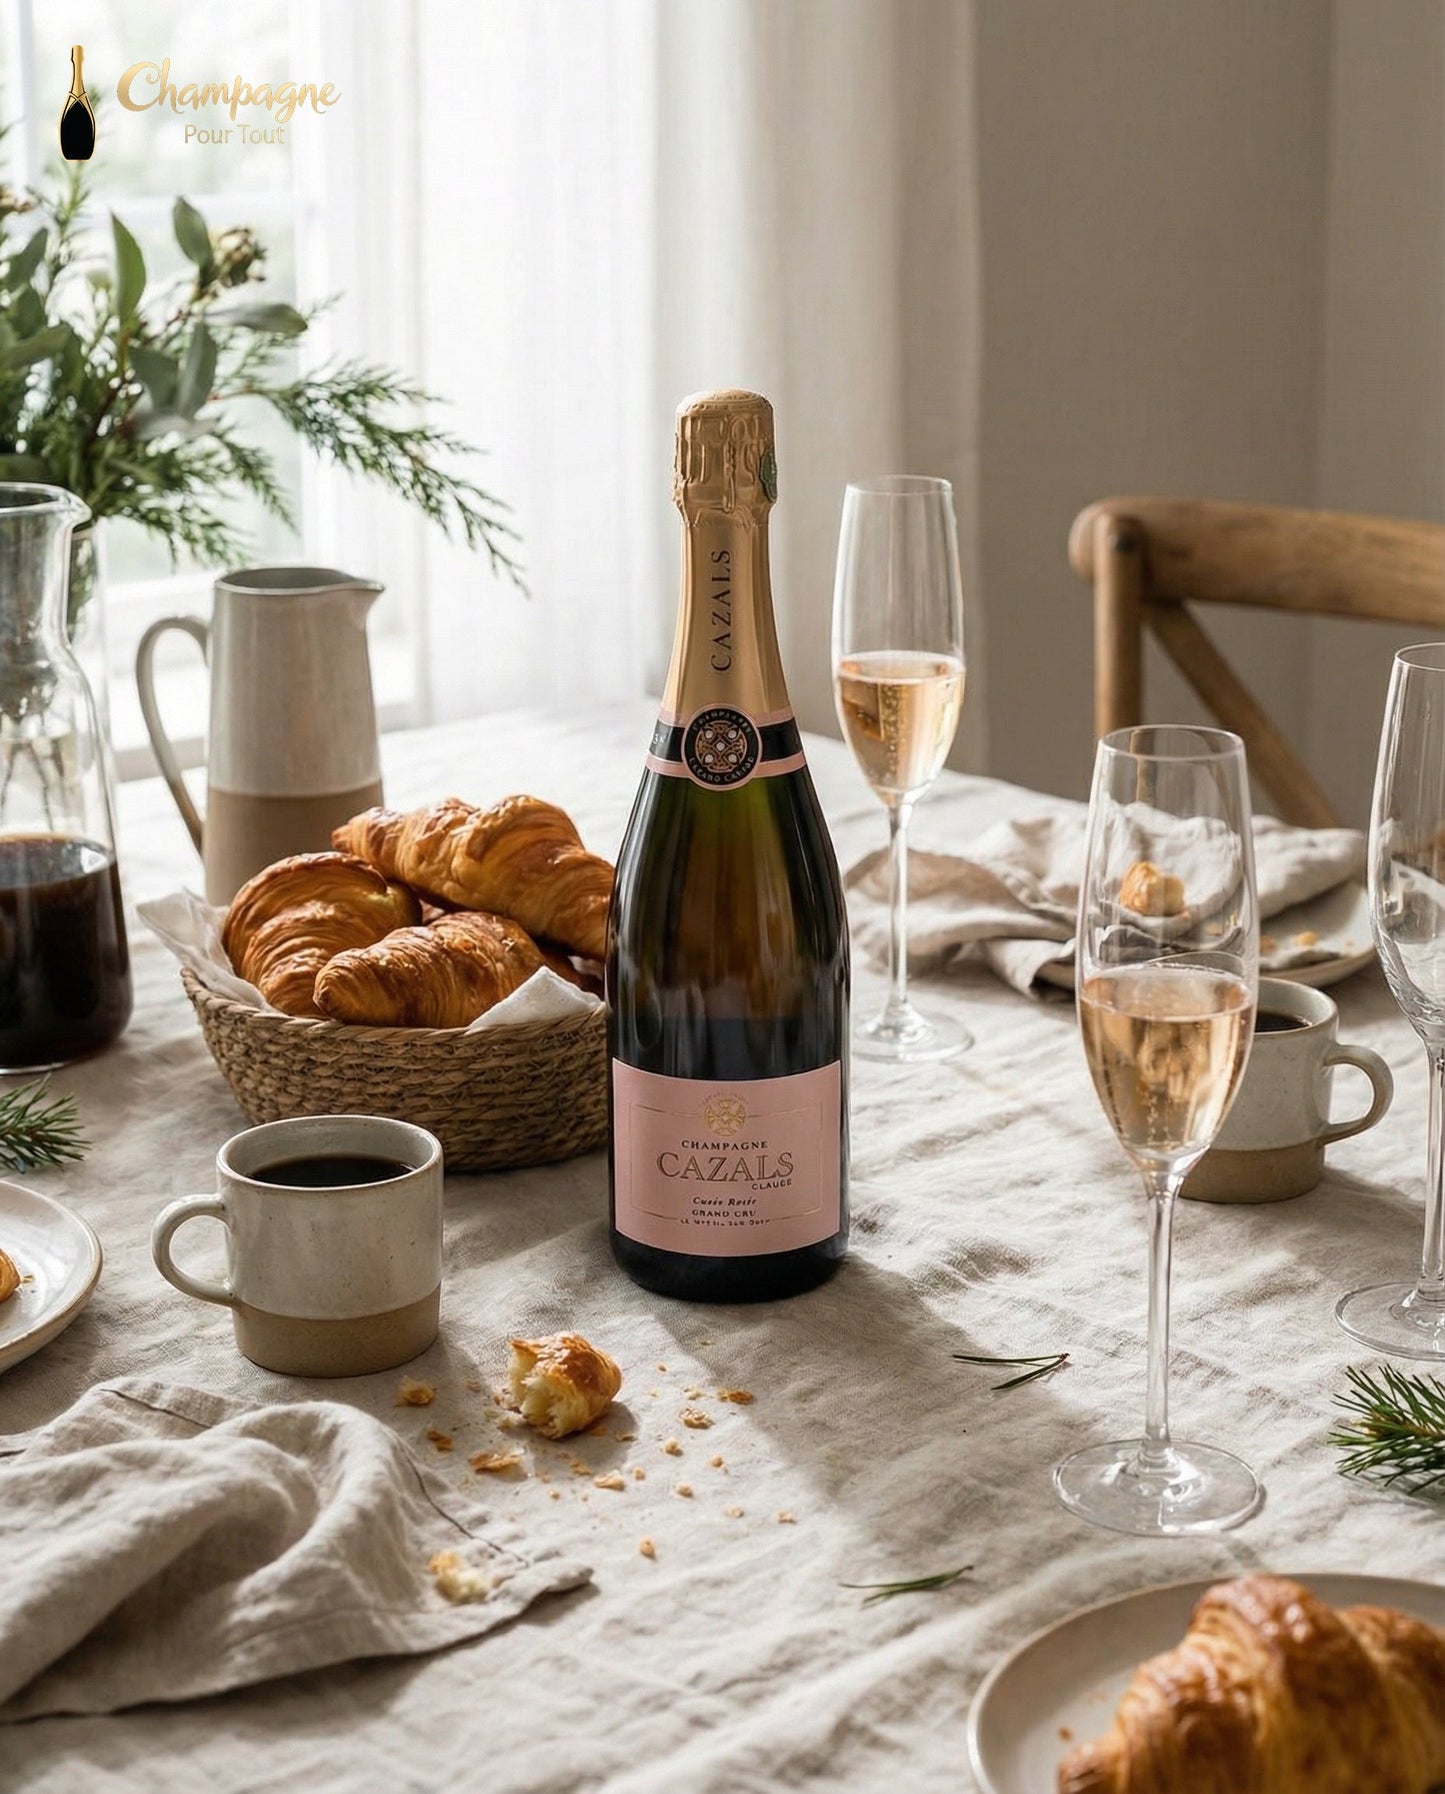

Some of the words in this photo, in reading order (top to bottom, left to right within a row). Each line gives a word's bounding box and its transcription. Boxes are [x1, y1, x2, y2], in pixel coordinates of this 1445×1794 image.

[711, 550, 732, 672] CAZALS
[681, 1140, 769, 1151] CHAMPAGNE
[656, 1152, 794, 1182] CAZALS
[691, 1209, 730, 1218] GRAND
[734, 1209, 757, 1218] CRU
